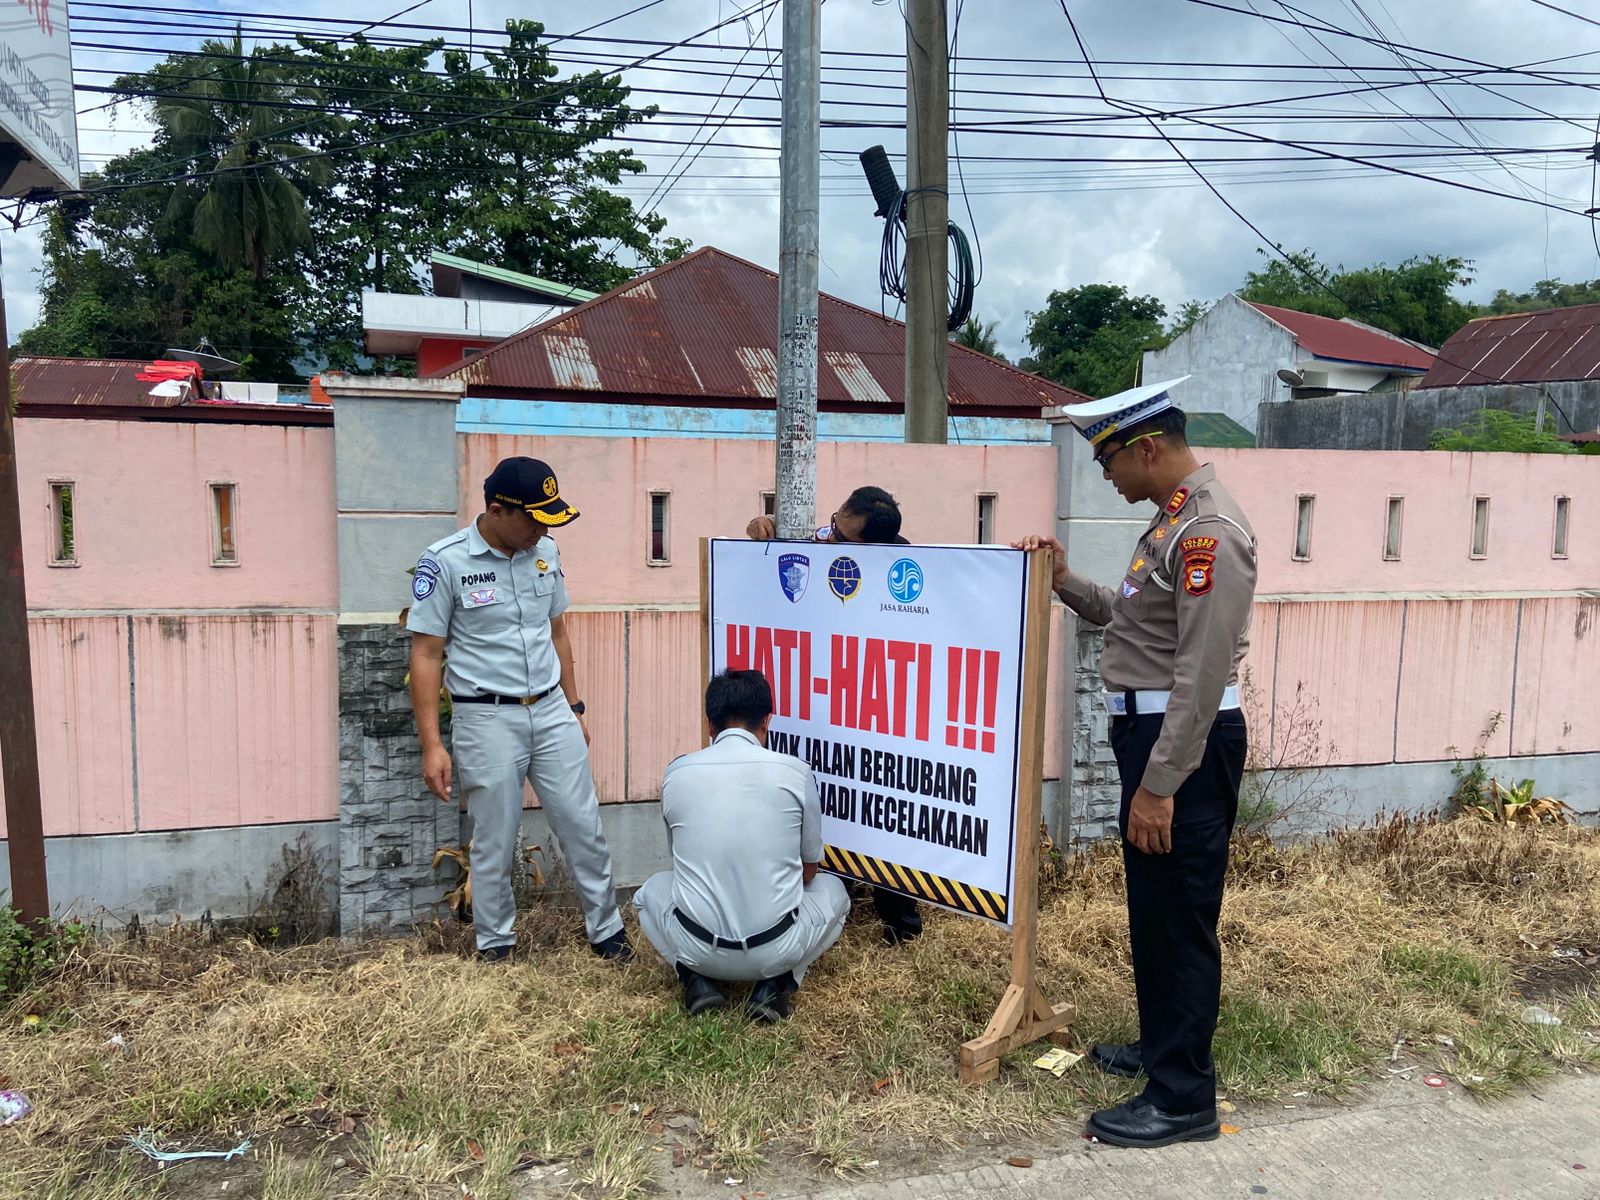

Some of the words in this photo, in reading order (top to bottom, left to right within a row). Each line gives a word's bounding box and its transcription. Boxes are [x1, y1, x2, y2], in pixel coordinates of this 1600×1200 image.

[461, 572, 496, 586] POPANG
[880, 603, 897, 612] JASA
[898, 604, 930, 615] RAHARJA
[945, 646, 1000, 753] !!!
[767, 730, 801, 758] YAK
[860, 747, 977, 807] BERLUBANG
[820, 781, 857, 823] JADI
[861, 791, 989, 857] KECELAKAAN
